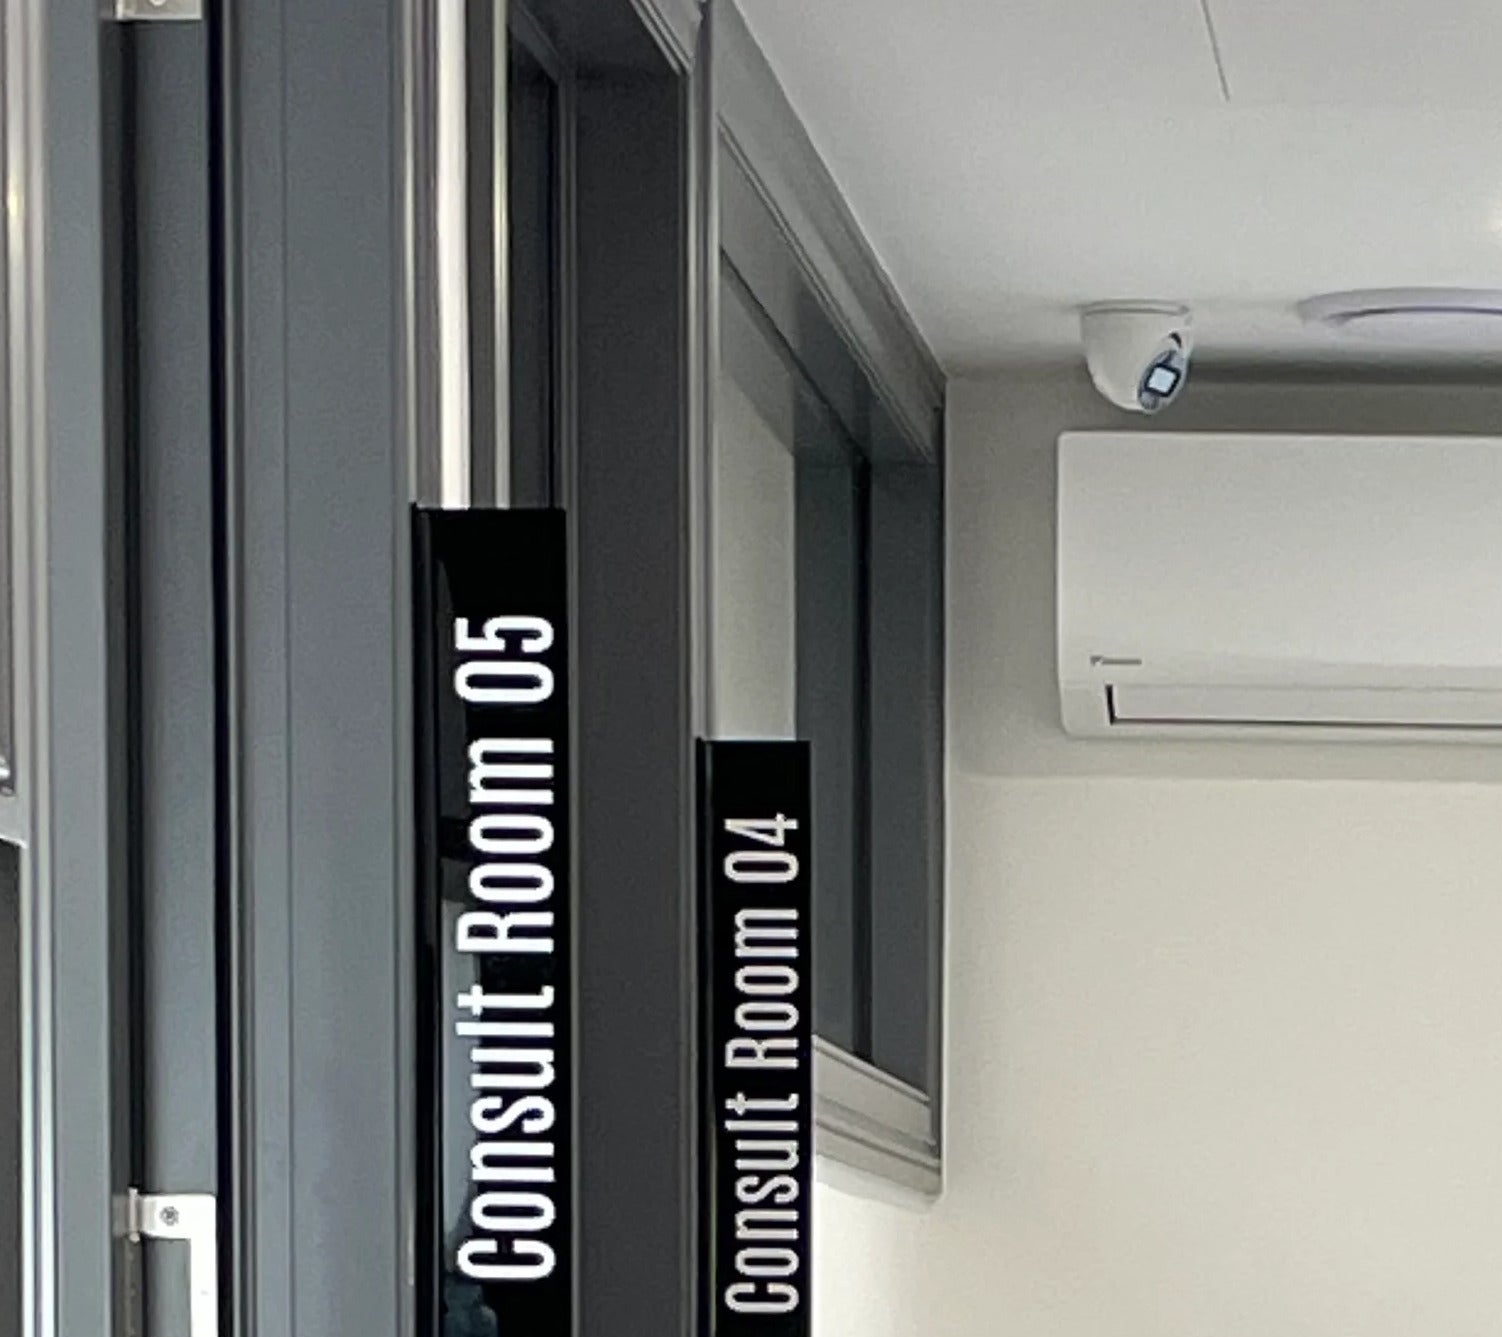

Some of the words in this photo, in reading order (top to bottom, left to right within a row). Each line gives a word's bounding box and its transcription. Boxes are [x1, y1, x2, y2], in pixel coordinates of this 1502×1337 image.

[453, 615, 556, 704] 05
[455, 737, 556, 954] Room
[723, 812, 800, 883] 04
[724, 908, 800, 1069] Room
[454, 983, 557, 1281] Consult
[724, 1091, 800, 1313] Consult
